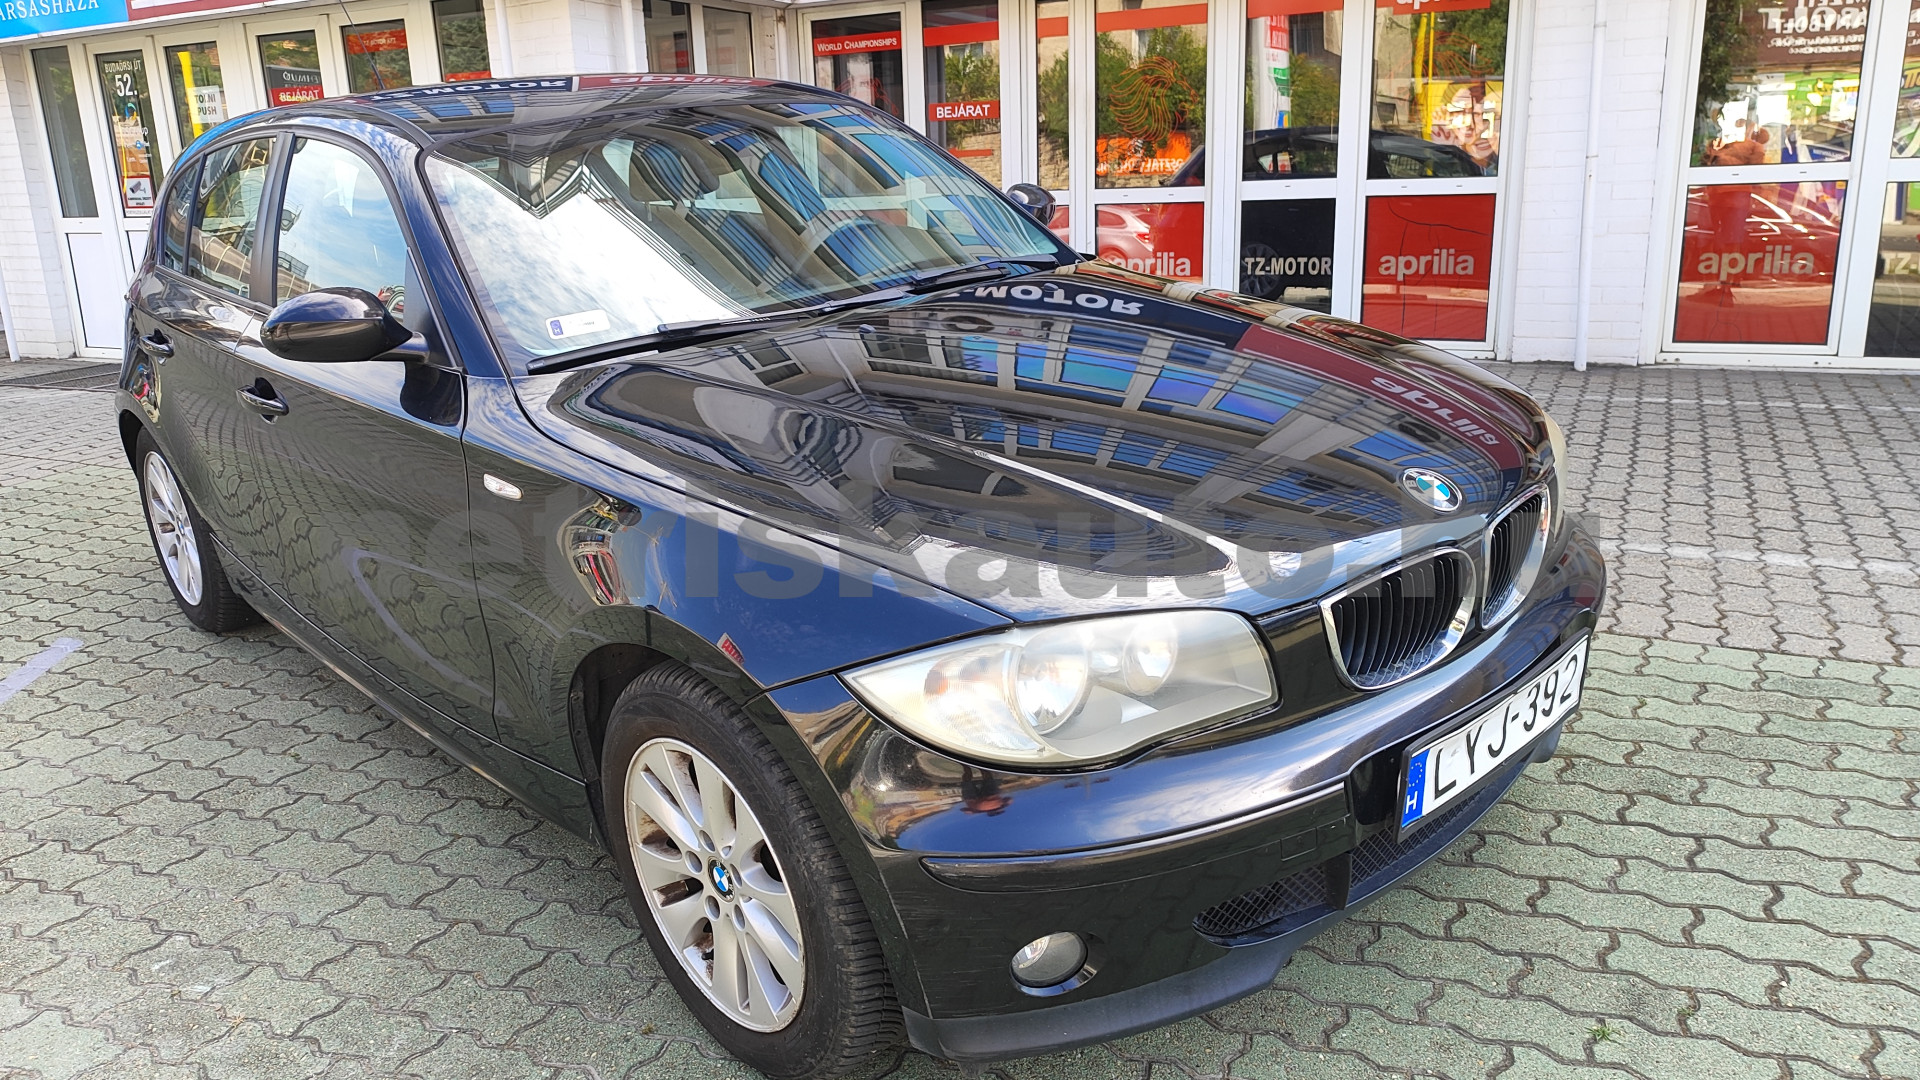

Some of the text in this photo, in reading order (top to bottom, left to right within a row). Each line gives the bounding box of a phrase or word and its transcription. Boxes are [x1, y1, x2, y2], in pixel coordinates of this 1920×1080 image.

[817, 38, 897, 52] WORLD CHAMPIONSHIPS
[115, 73, 138, 97] 52.
[278, 88, 320, 103] BEJÁRAT
[197, 105, 217, 116] PUSH
[936, 104, 991, 119] BEJÁRAT
[1113, 252, 1191, 277] aprilia
[1244, 256, 1332, 276] TZ-MOTOR
[1378, 249, 1475, 281] aprilia
[1697, 245, 1815, 281] aprilia
[1434, 654, 1578, 800] LYJ-392
[1405, 790, 1417, 815] H
